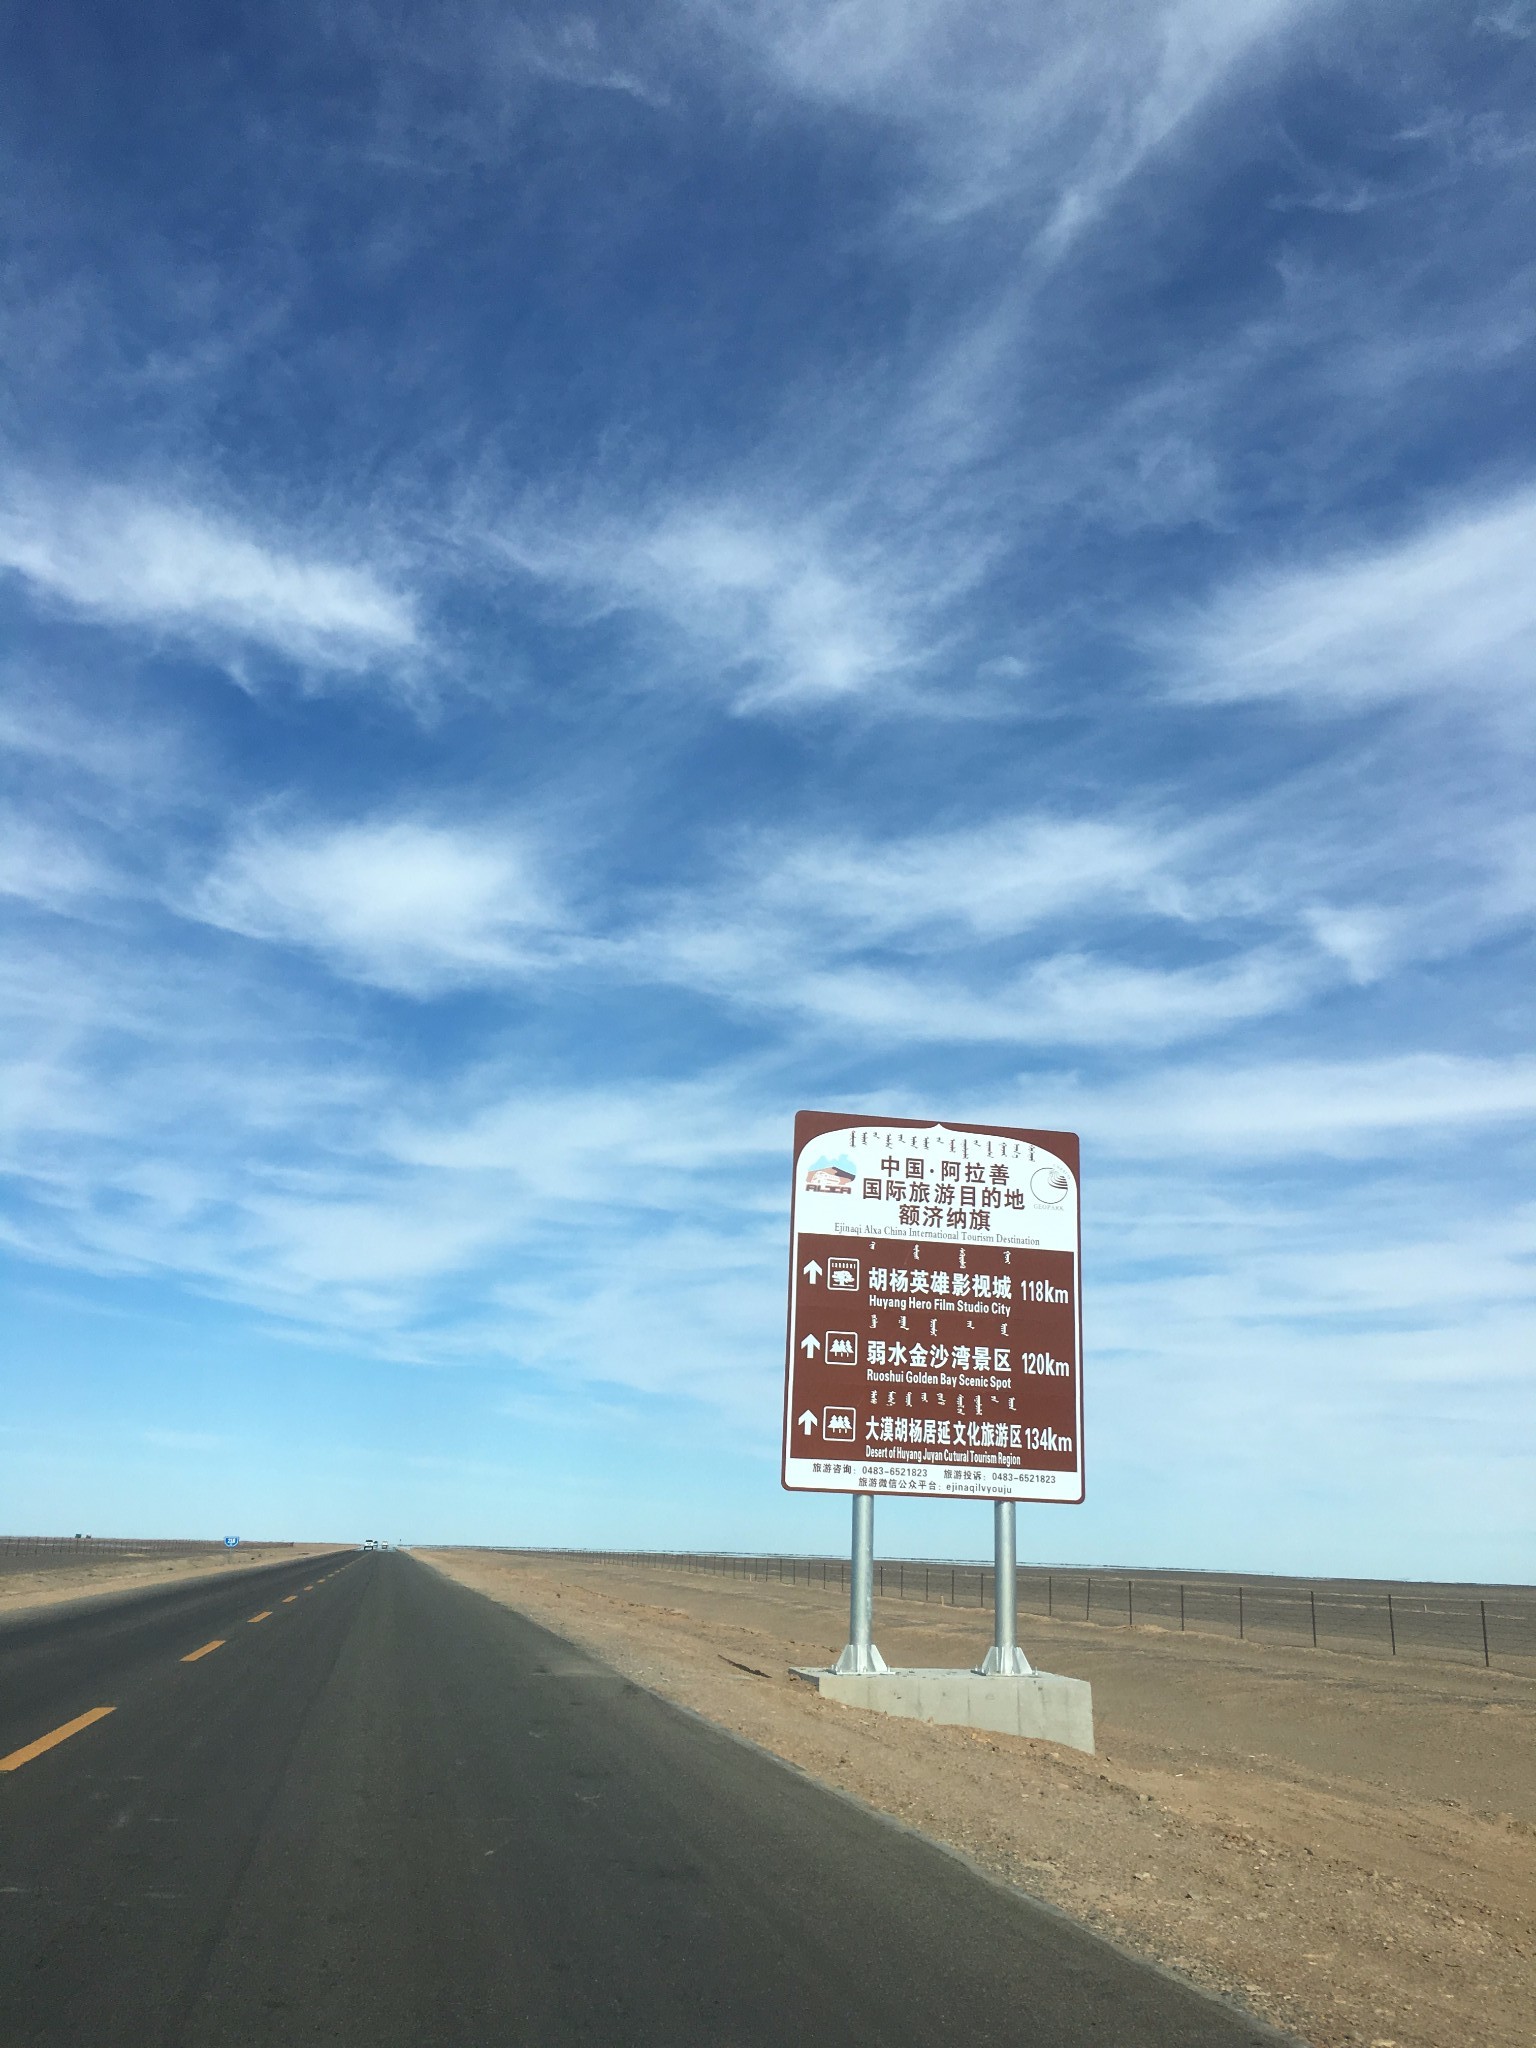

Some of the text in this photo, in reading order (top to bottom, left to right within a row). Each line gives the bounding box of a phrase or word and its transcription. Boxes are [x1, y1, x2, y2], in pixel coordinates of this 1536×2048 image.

[880, 1155, 1010, 1186] 中国·阿拉善
[862, 1178, 1025, 1210] 国际旅游目的地
[898, 1204, 991, 1231] 额济纳旗
[834, 1222, 1040, 1246] Ejinaqi Alxa China International Tourism Destination
[868, 1267, 1012, 1299] 胡杨英雄影视城
[1020, 1279, 1069, 1304] 118km
[869, 1295, 1011, 1318] Huyang Hero Film Studio City
[866, 1340, 1012, 1372] 弱水金沙湾景区
[1021, 1352, 1070, 1377] 120km
[866, 1369, 1011, 1389] Ruoshui Golden Bay Scenic Spot
[865, 1415, 1023, 1448] 大漠胡杨居延文化旅游区
[1025, 1427, 1072, 1452] 134km
[865, 1445, 887, 1458] Desert
[888, 1446, 896, 1458] of
[896, 1447, 922, 1463] Huyang
[922, 1448, 943, 1463] Juyan
[970, 1451, 996, 1464] Tourism
[998, 1452, 1021, 1467] Region
[862, 1466, 928, 1478] 0483-6521823
[992, 1472, 1056, 1484] 0483-6521823
